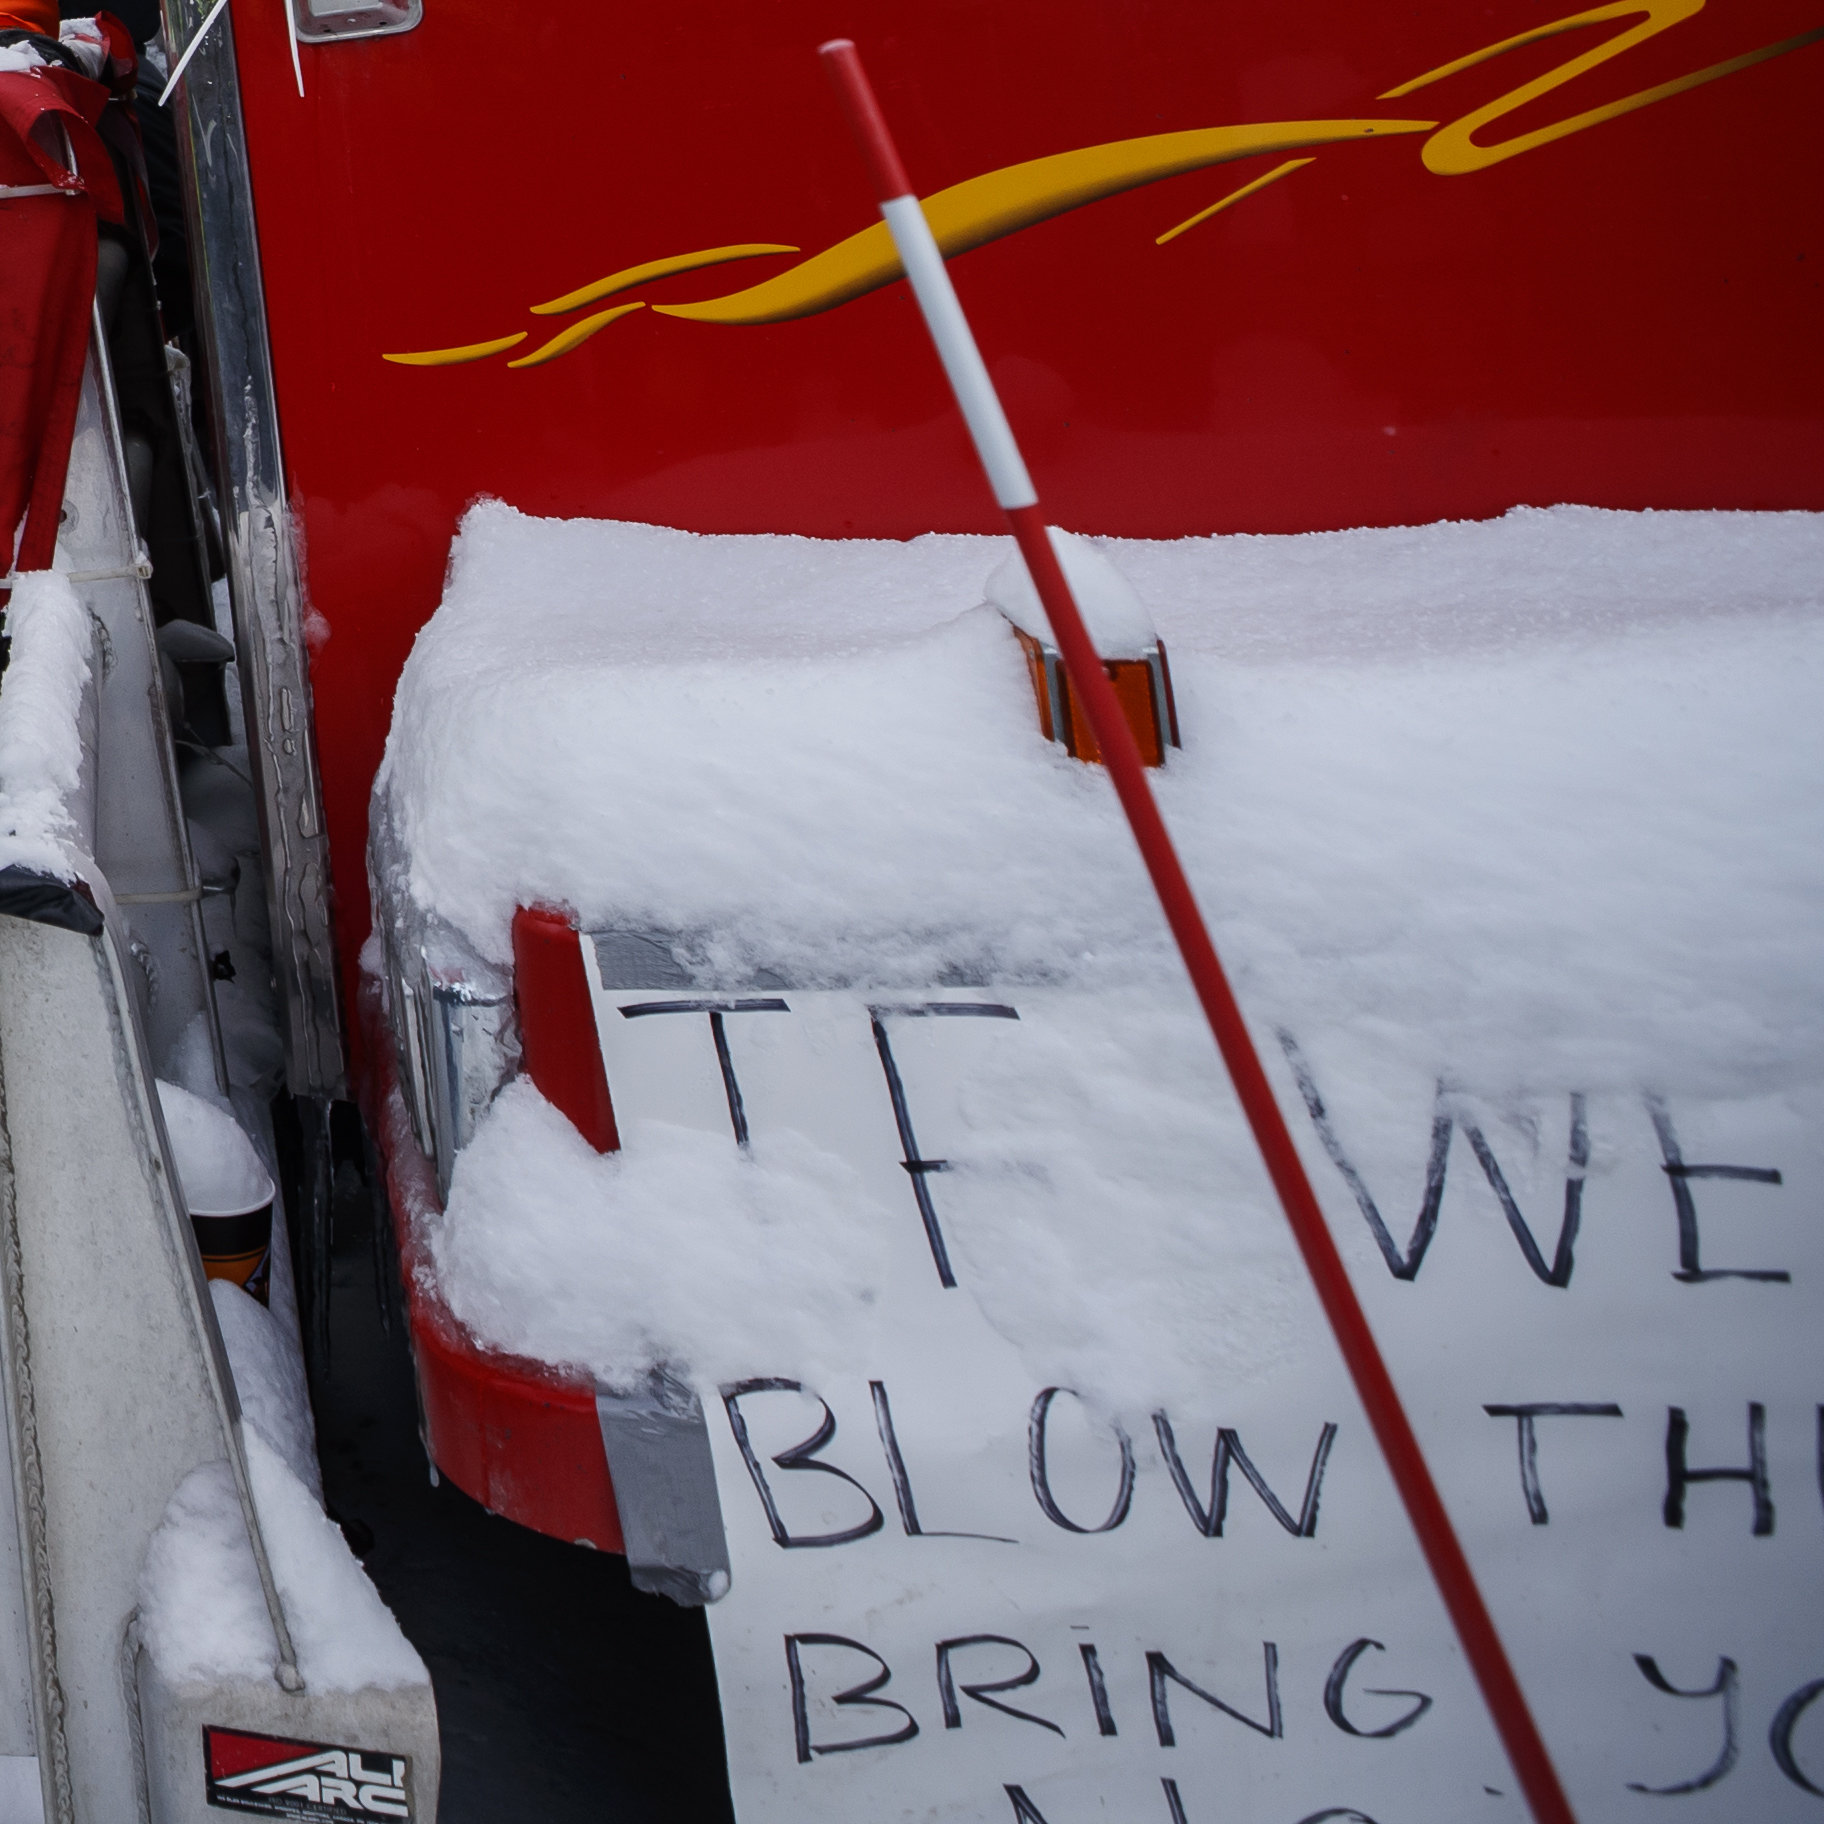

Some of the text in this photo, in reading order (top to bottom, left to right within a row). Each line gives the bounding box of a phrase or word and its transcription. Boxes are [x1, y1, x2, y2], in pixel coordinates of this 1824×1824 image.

[1277, 1026, 1792, 1288] WE
[720, 1376, 1824, 1549] BLOW TH
[250, 1774, 409, 1818] ARC
